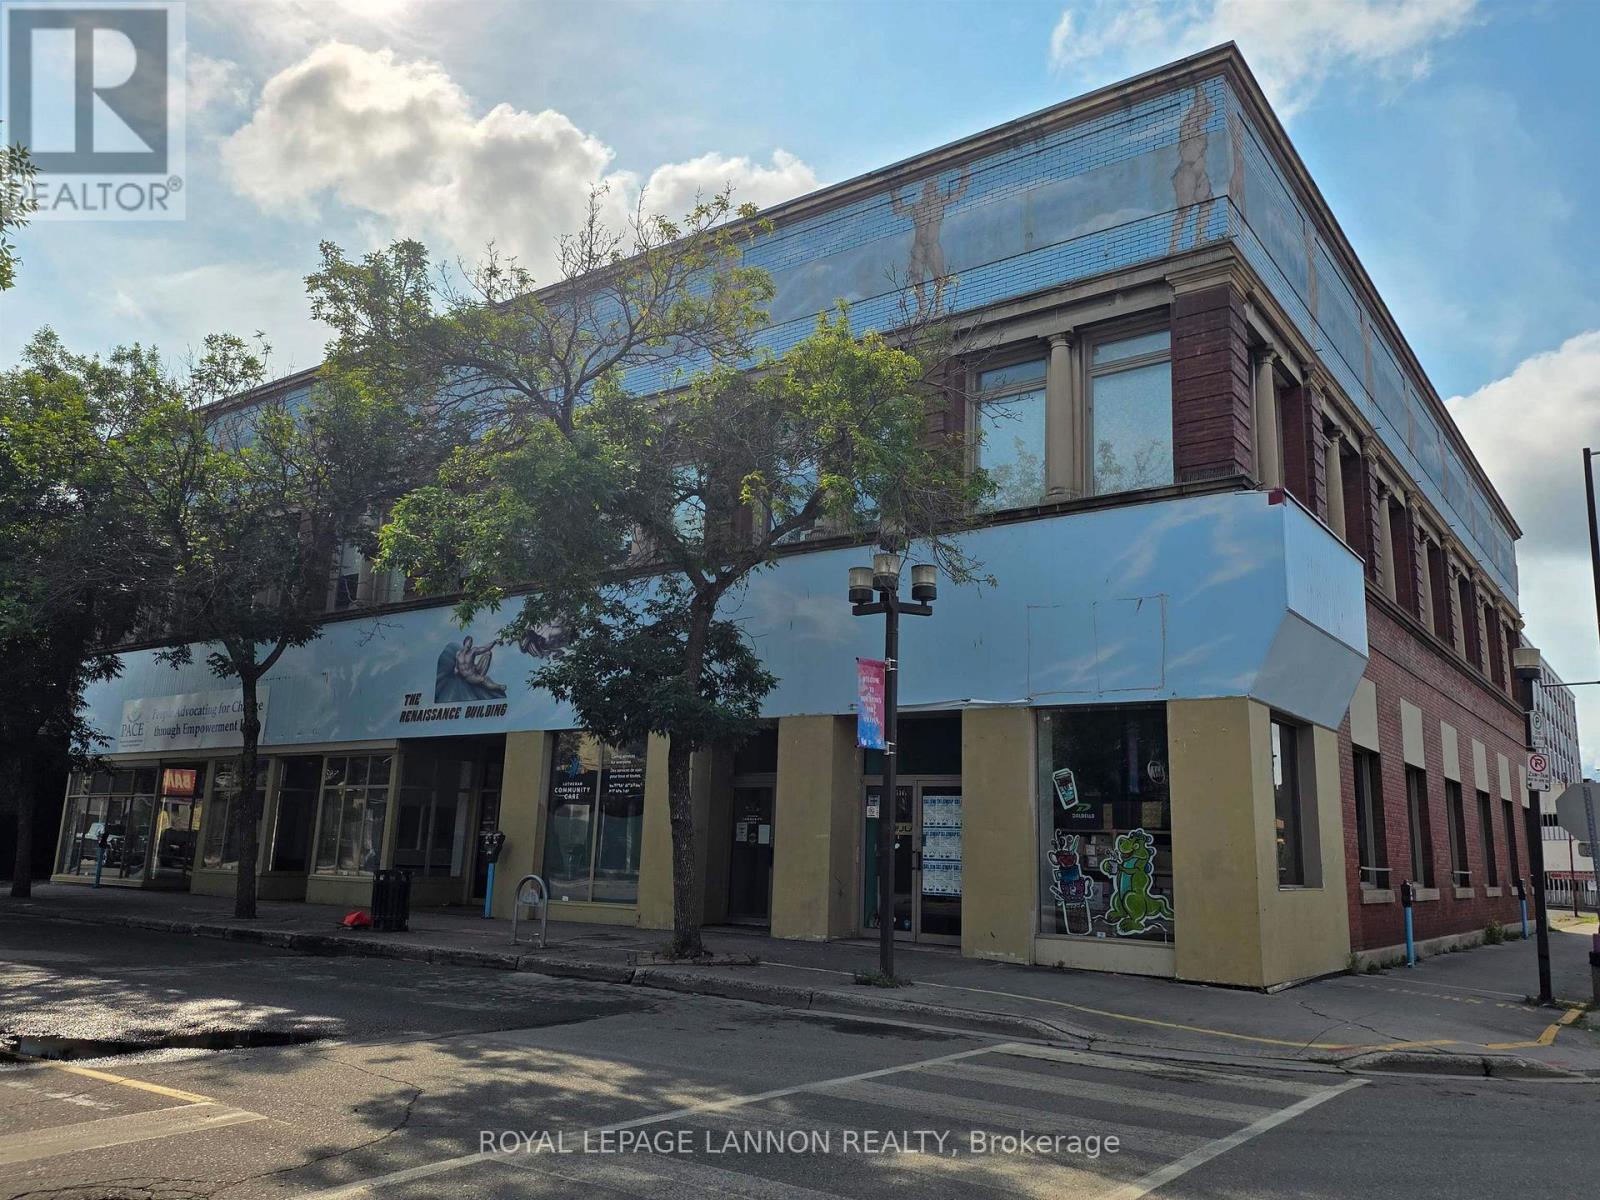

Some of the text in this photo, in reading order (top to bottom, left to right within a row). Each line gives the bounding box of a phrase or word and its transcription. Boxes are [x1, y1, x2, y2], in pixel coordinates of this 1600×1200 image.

[404, 693, 422, 706] THE
[175, 702, 217, 718] Advocating
[218, 701, 231, 715] for
[231, 700, 264, 713] Che
[399, 703, 508, 723] RENAISSANCE BUILDING
[120, 722, 144, 738] PACE
[154, 722, 181, 738] through
[182, 720, 237, 738] Empowerment
[554, 786, 591, 794] COMMUNITY
